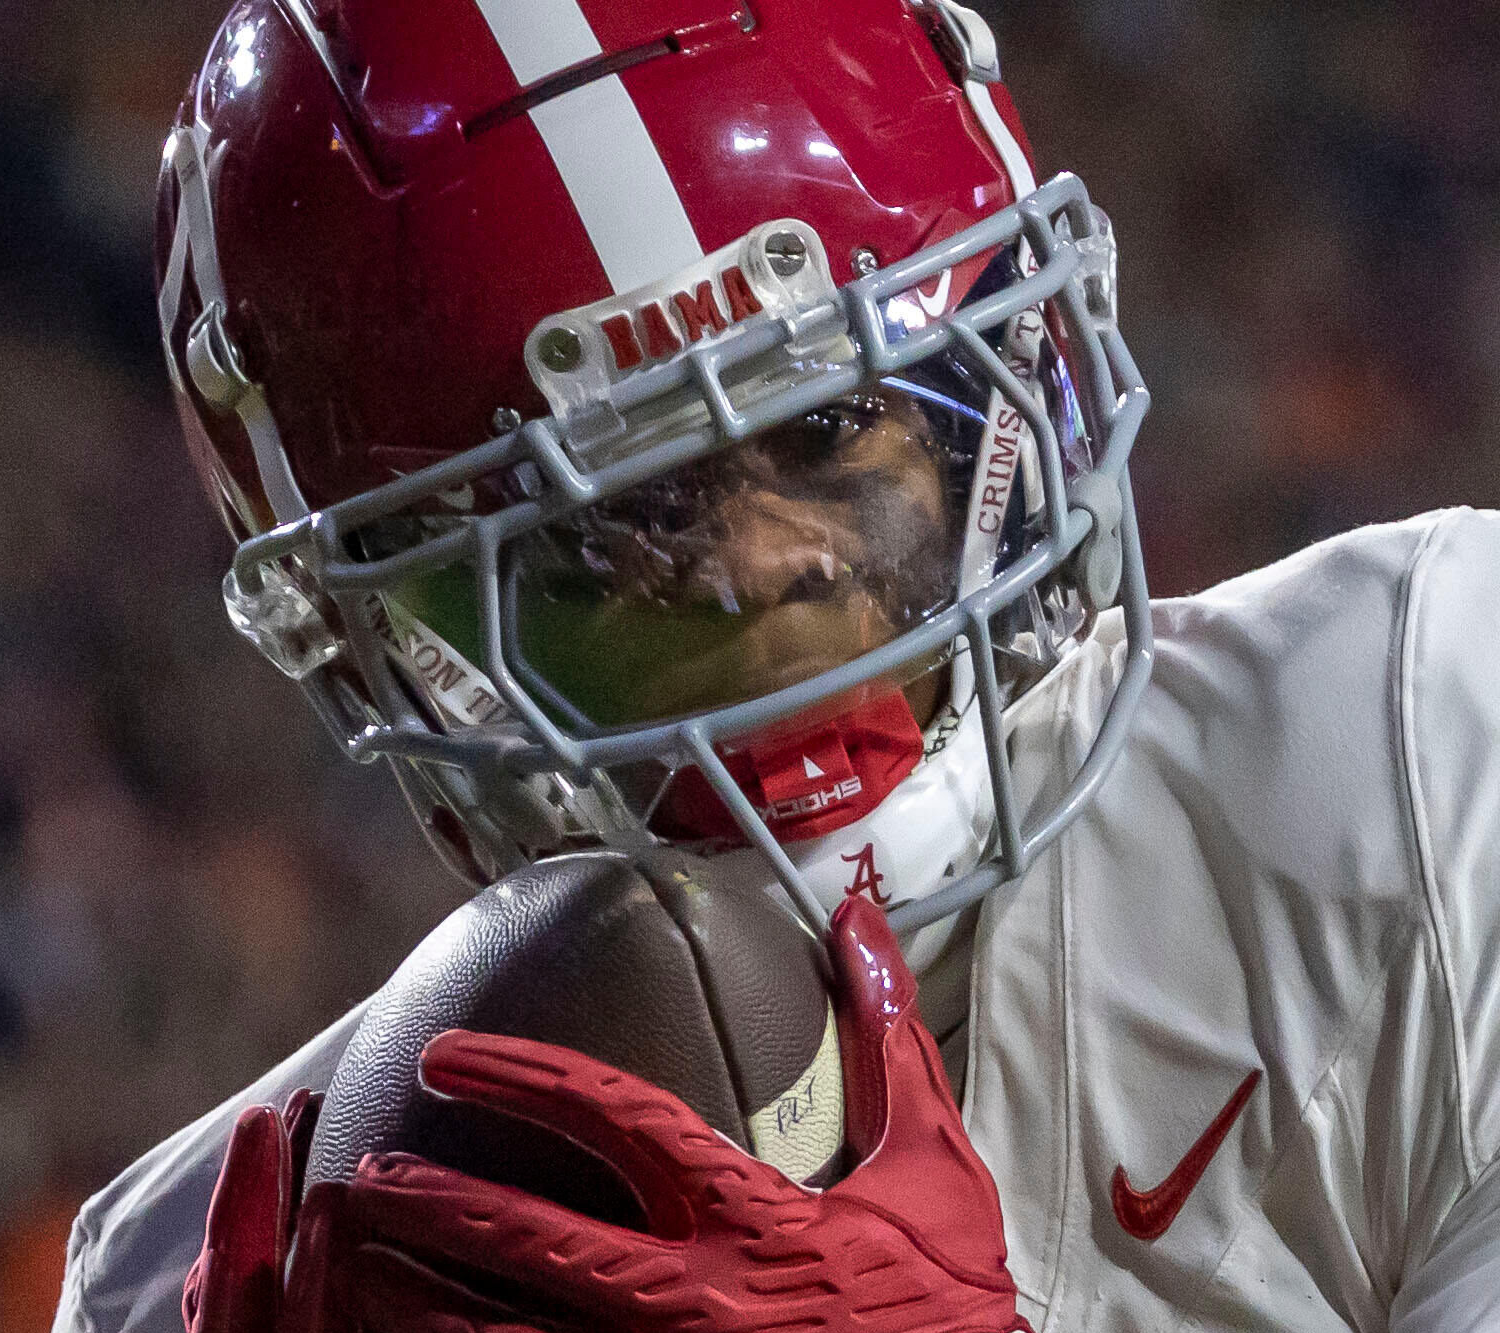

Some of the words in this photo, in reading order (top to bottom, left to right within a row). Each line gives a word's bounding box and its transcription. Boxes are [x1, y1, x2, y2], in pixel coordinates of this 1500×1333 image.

[601, 265, 764, 370] BAMA
[977, 354, 1033, 534] CRIMSN
[840, 842, 893, 905] A
